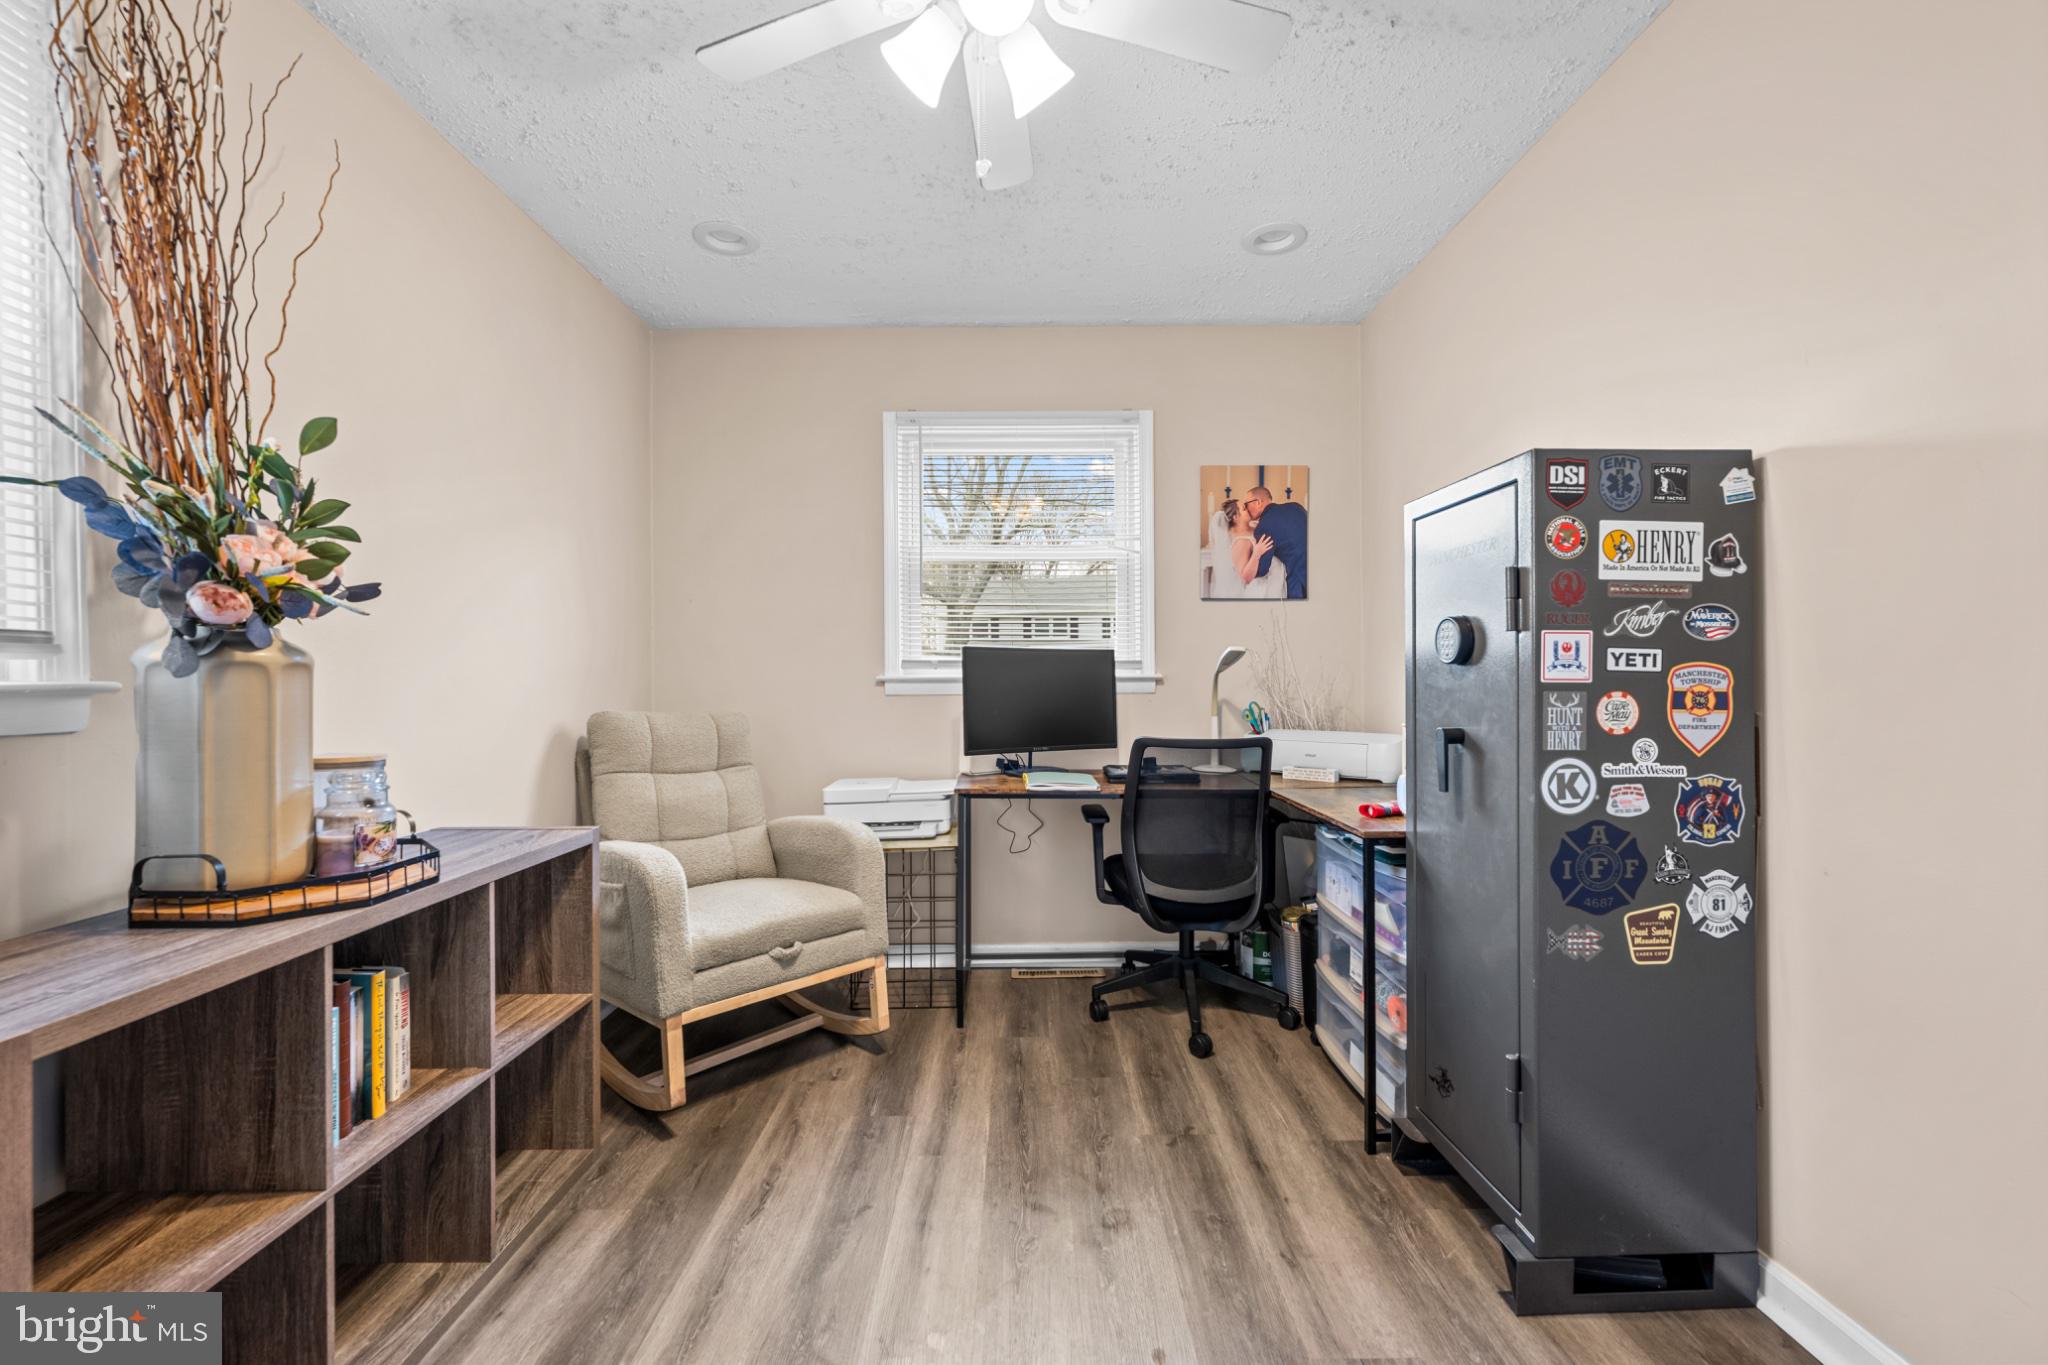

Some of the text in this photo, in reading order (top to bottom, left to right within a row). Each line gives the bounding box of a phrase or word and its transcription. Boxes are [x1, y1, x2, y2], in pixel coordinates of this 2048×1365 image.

[1603, 457, 1637, 470] EMT
[1654, 466, 1688, 476] ECKERT
[1549, 465, 1585, 485] DSI
[1637, 529, 1697, 565] HENRY
[1603, 600, 1680, 637] Kimber
[1610, 652, 1657, 668] YETI
[1675, 670, 1727, 681] MANCHESTER
[1680, 678, 1721, 686] TOWNSHIP
[1547, 707, 1583, 725] HUNT
[1604, 711, 1631, 722] May
[1547, 730, 1583, 750] HENRY
[1588, 825, 1609, 844] A
[1563, 860, 1572, 879] I
[1590, 858, 1608, 879] F
[1625, 859, 1639, 878] F
[1584, 897, 1615, 908] 4687
[1712, 898, 1725, 911] 81
